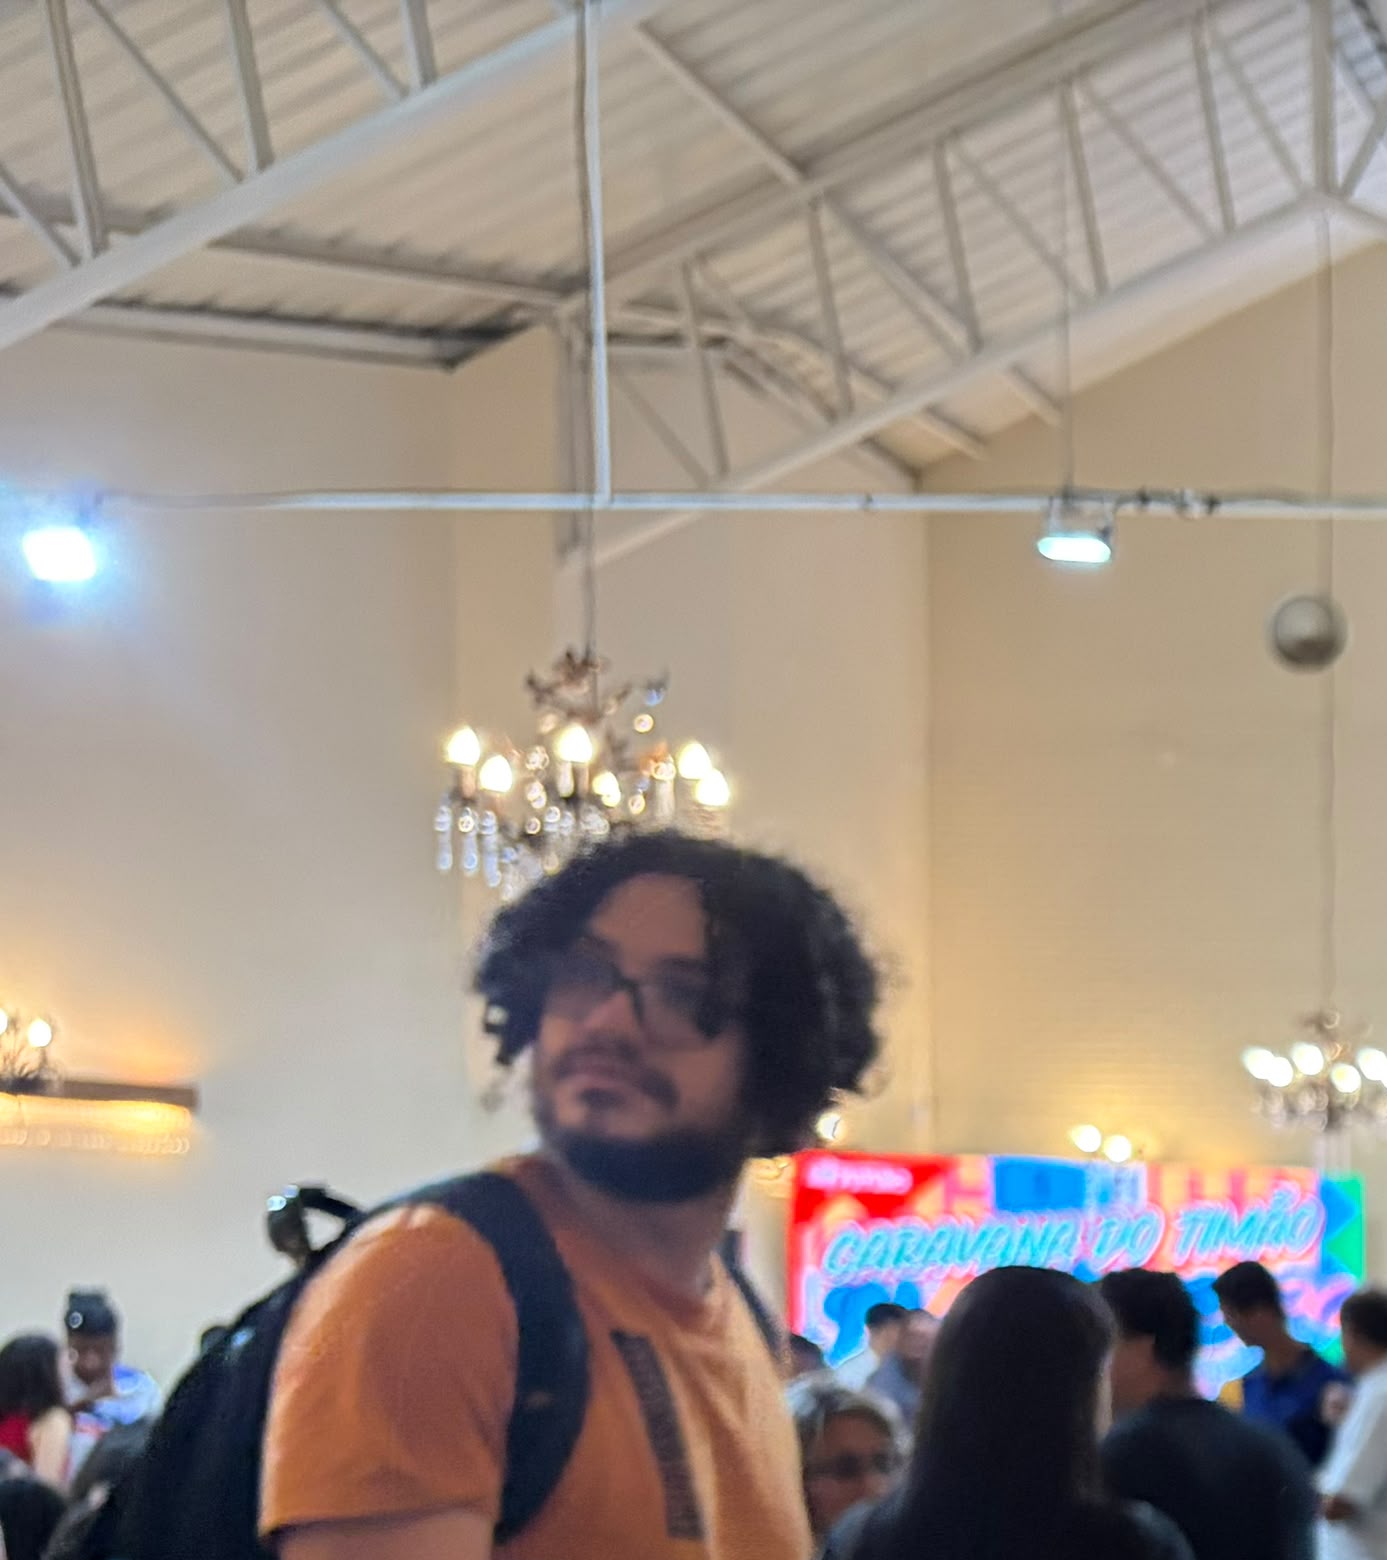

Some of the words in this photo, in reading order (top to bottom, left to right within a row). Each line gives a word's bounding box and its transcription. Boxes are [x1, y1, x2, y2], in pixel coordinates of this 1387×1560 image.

[823, 1213, 1082, 1277] CARAVANA
[1092, 1203, 1163, 1269] DO
[1174, 1184, 1323, 1257] TIMÃO
